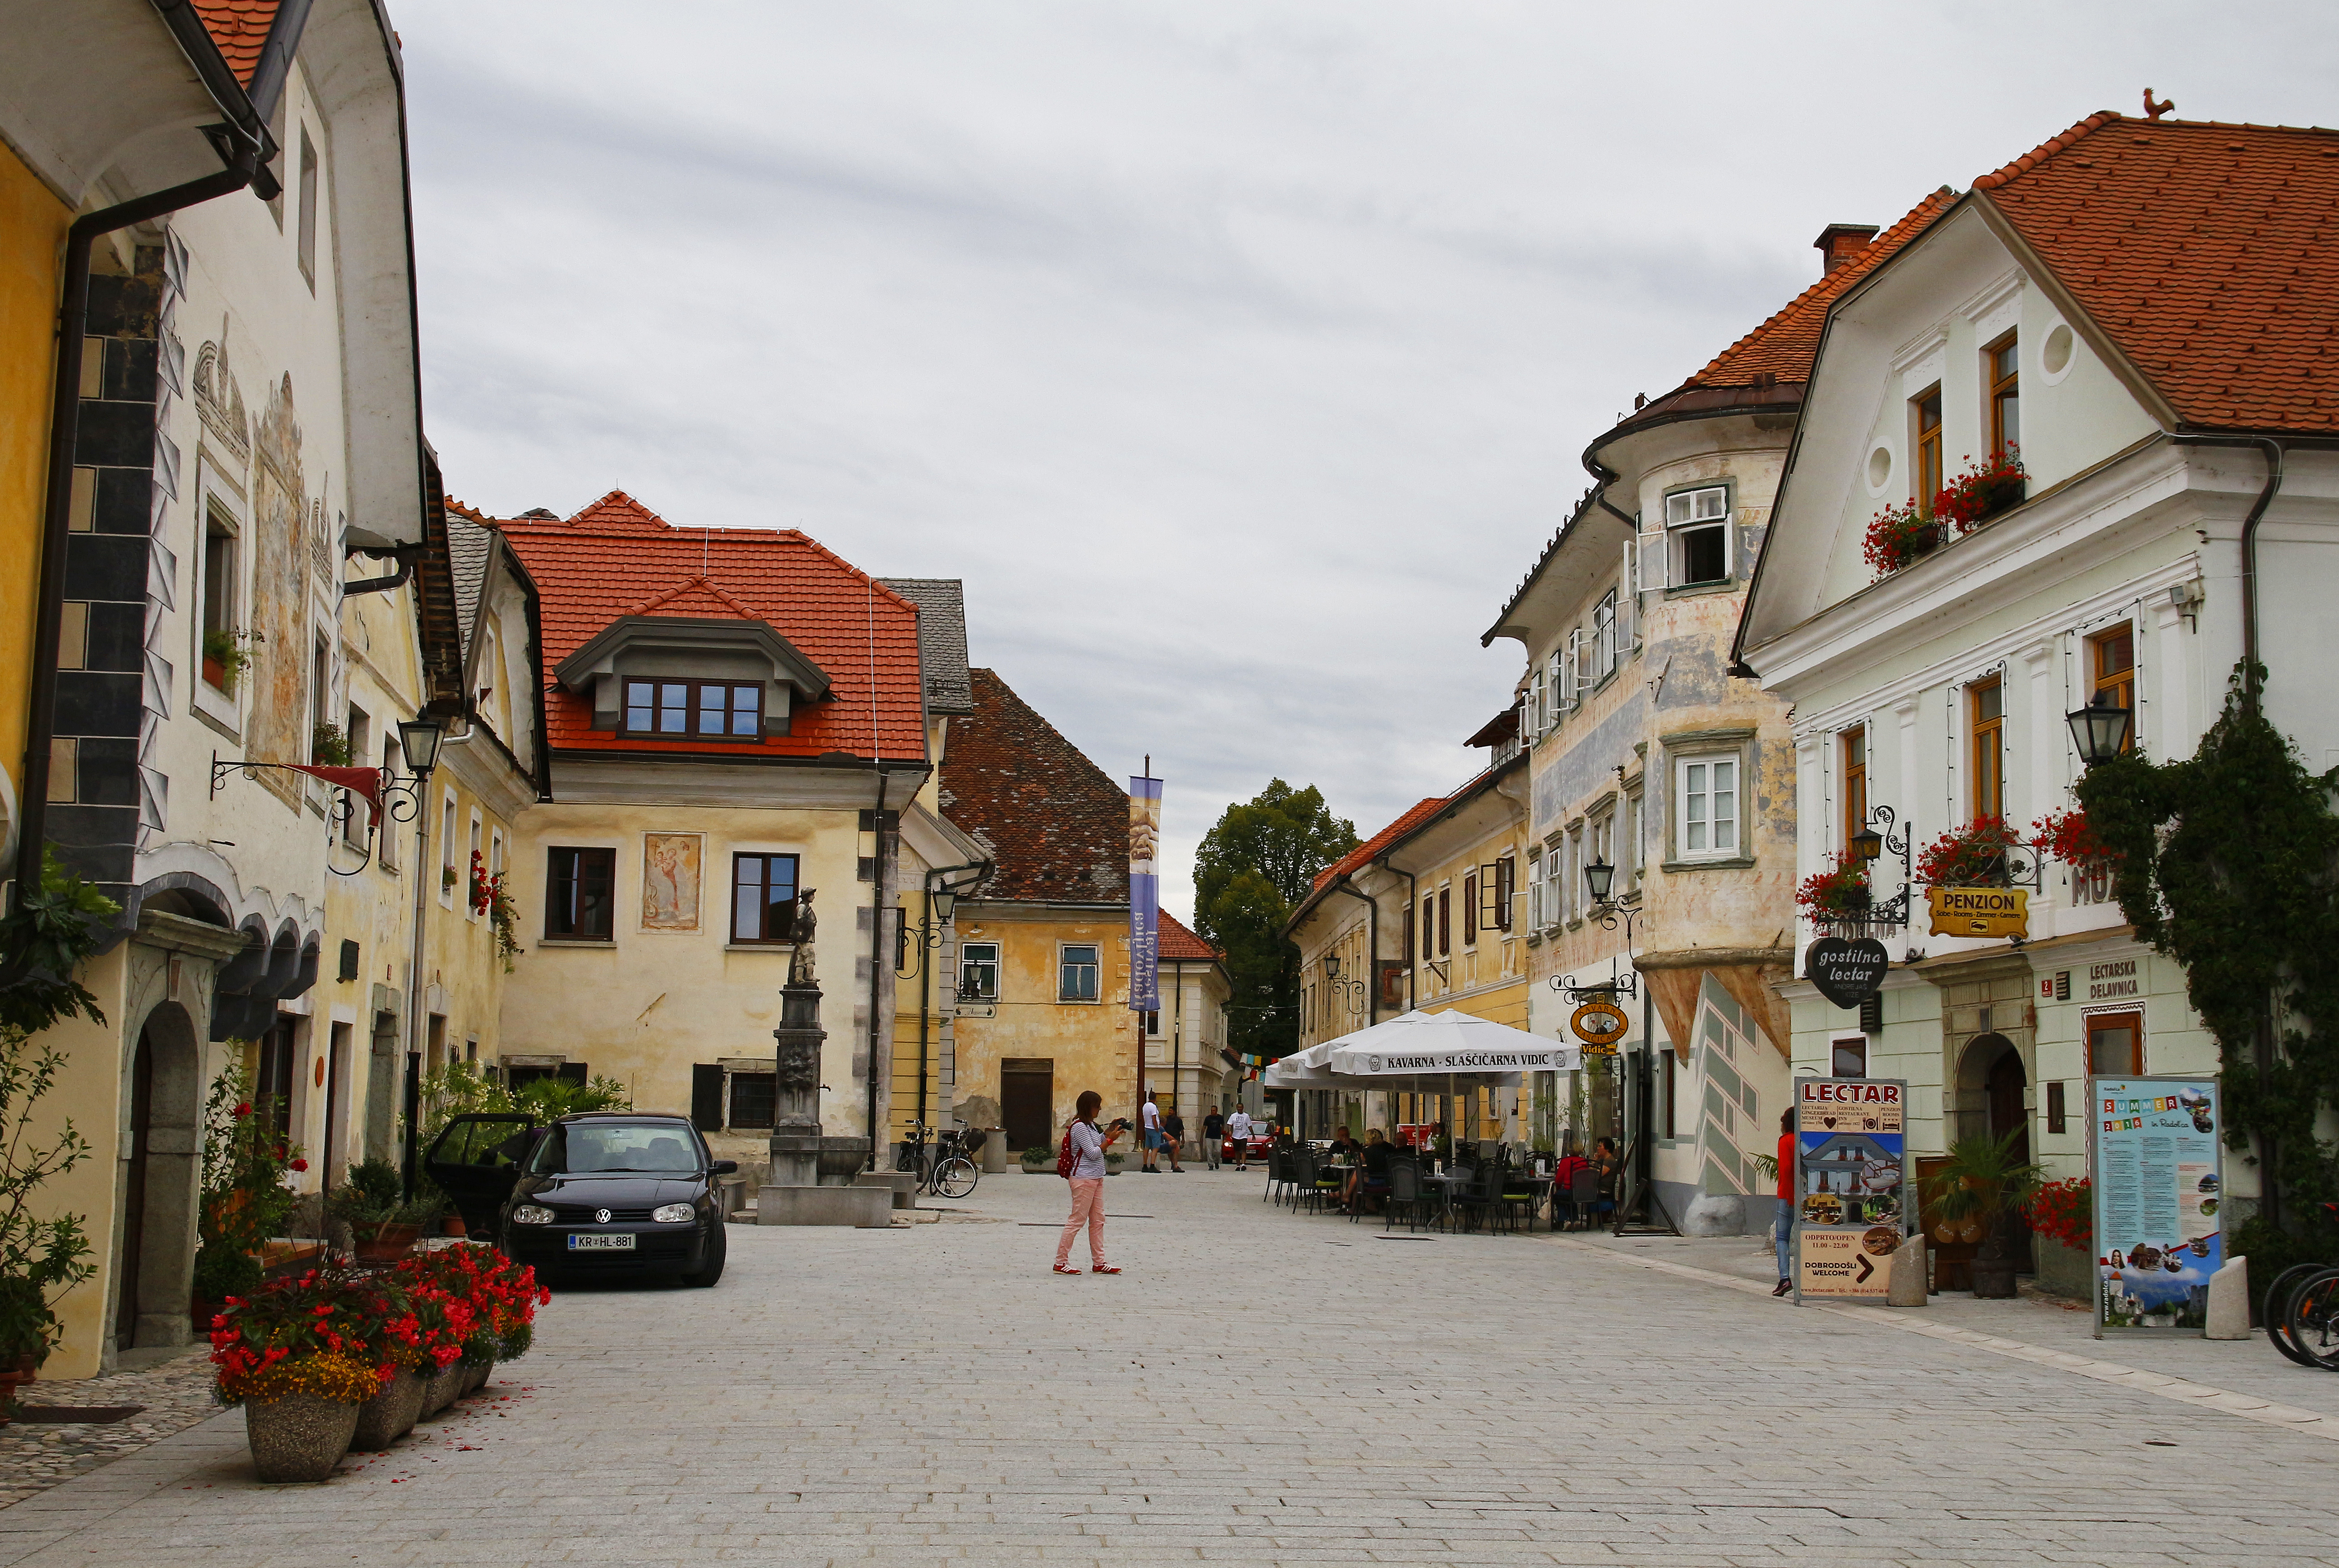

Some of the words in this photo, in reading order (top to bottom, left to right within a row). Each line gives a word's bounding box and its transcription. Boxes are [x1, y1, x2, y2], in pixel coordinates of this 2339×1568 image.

[1944, 894, 2014, 910] PENZION
[1819, 949, 1881, 966] gostilna
[1829, 966, 1872, 981] lectar
[2090, 960, 2136, 981] LECTARSKA
[2044, 981, 2048, 990] 2
[2090, 979, 2138, 999] DELAVNICA
[1577, 1005, 1621, 1018] KAVARNA
[1582, 1045, 1606, 1054] Vidic
[1388, 1056, 1436, 1068] KAVARNA
[1445, 1053, 1517, 1067] SLAŠČIČARNA
[1520, 1054, 1549, 1065] VIDIC
[1802, 1083, 1899, 1104] LECTAR
[2106, 1099, 2176, 1110] SUMMER
[2105, 1120, 2139, 1129] 2016
[579, 1237, 592, 1247] KR
[600, 1236, 631, 1247] HL-881
